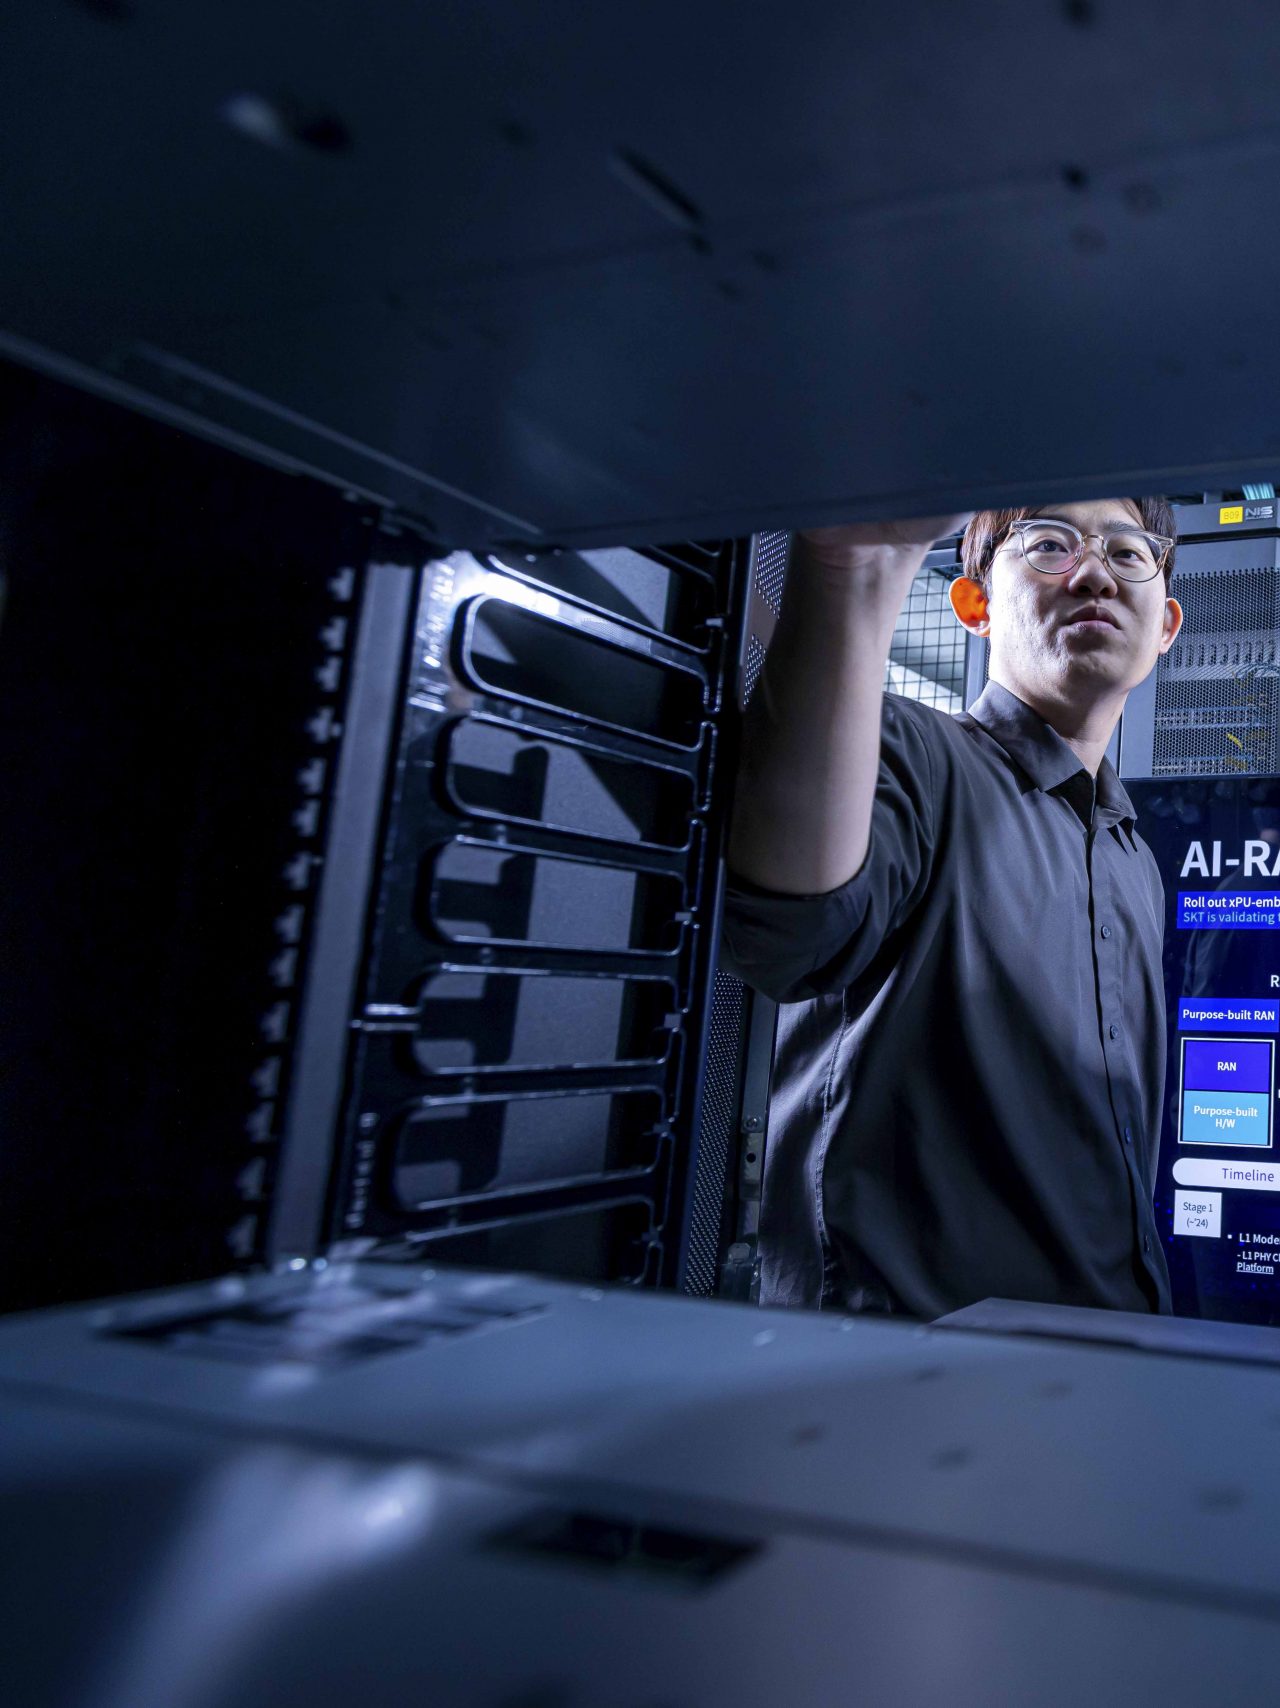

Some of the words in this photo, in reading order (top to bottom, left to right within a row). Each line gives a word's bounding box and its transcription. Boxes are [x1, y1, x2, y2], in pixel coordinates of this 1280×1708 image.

[1183, 896, 1205, 908] Roll
[1207, 897, 1226, 908] out
[1183, 911, 1205, 923] SKT
[1207, 911, 1217, 923] is
[1219, 912, 1274, 924] validating
[1183, 1009, 1251, 1021] Purpose-built
[1253, 1010, 1275, 1021] RAN
[1217, 1061, 1237, 1072] RAN
[1194, 1106, 1258, 1120] Purpose-built
[1215, 1118, 1236, 1130] H/W
[1222, 1168, 1274, 1182] Timeline
[1183, 1202, 1206, 1214] Stage
[1208, 1203, 1214, 1213] 1
[1239, 1232, 1251, 1243] L1
[1242, 1250, 1253, 1261] L1
[1253, 1251, 1272, 1262] PHY
[1236, 1262, 1274, 1274] Platform
